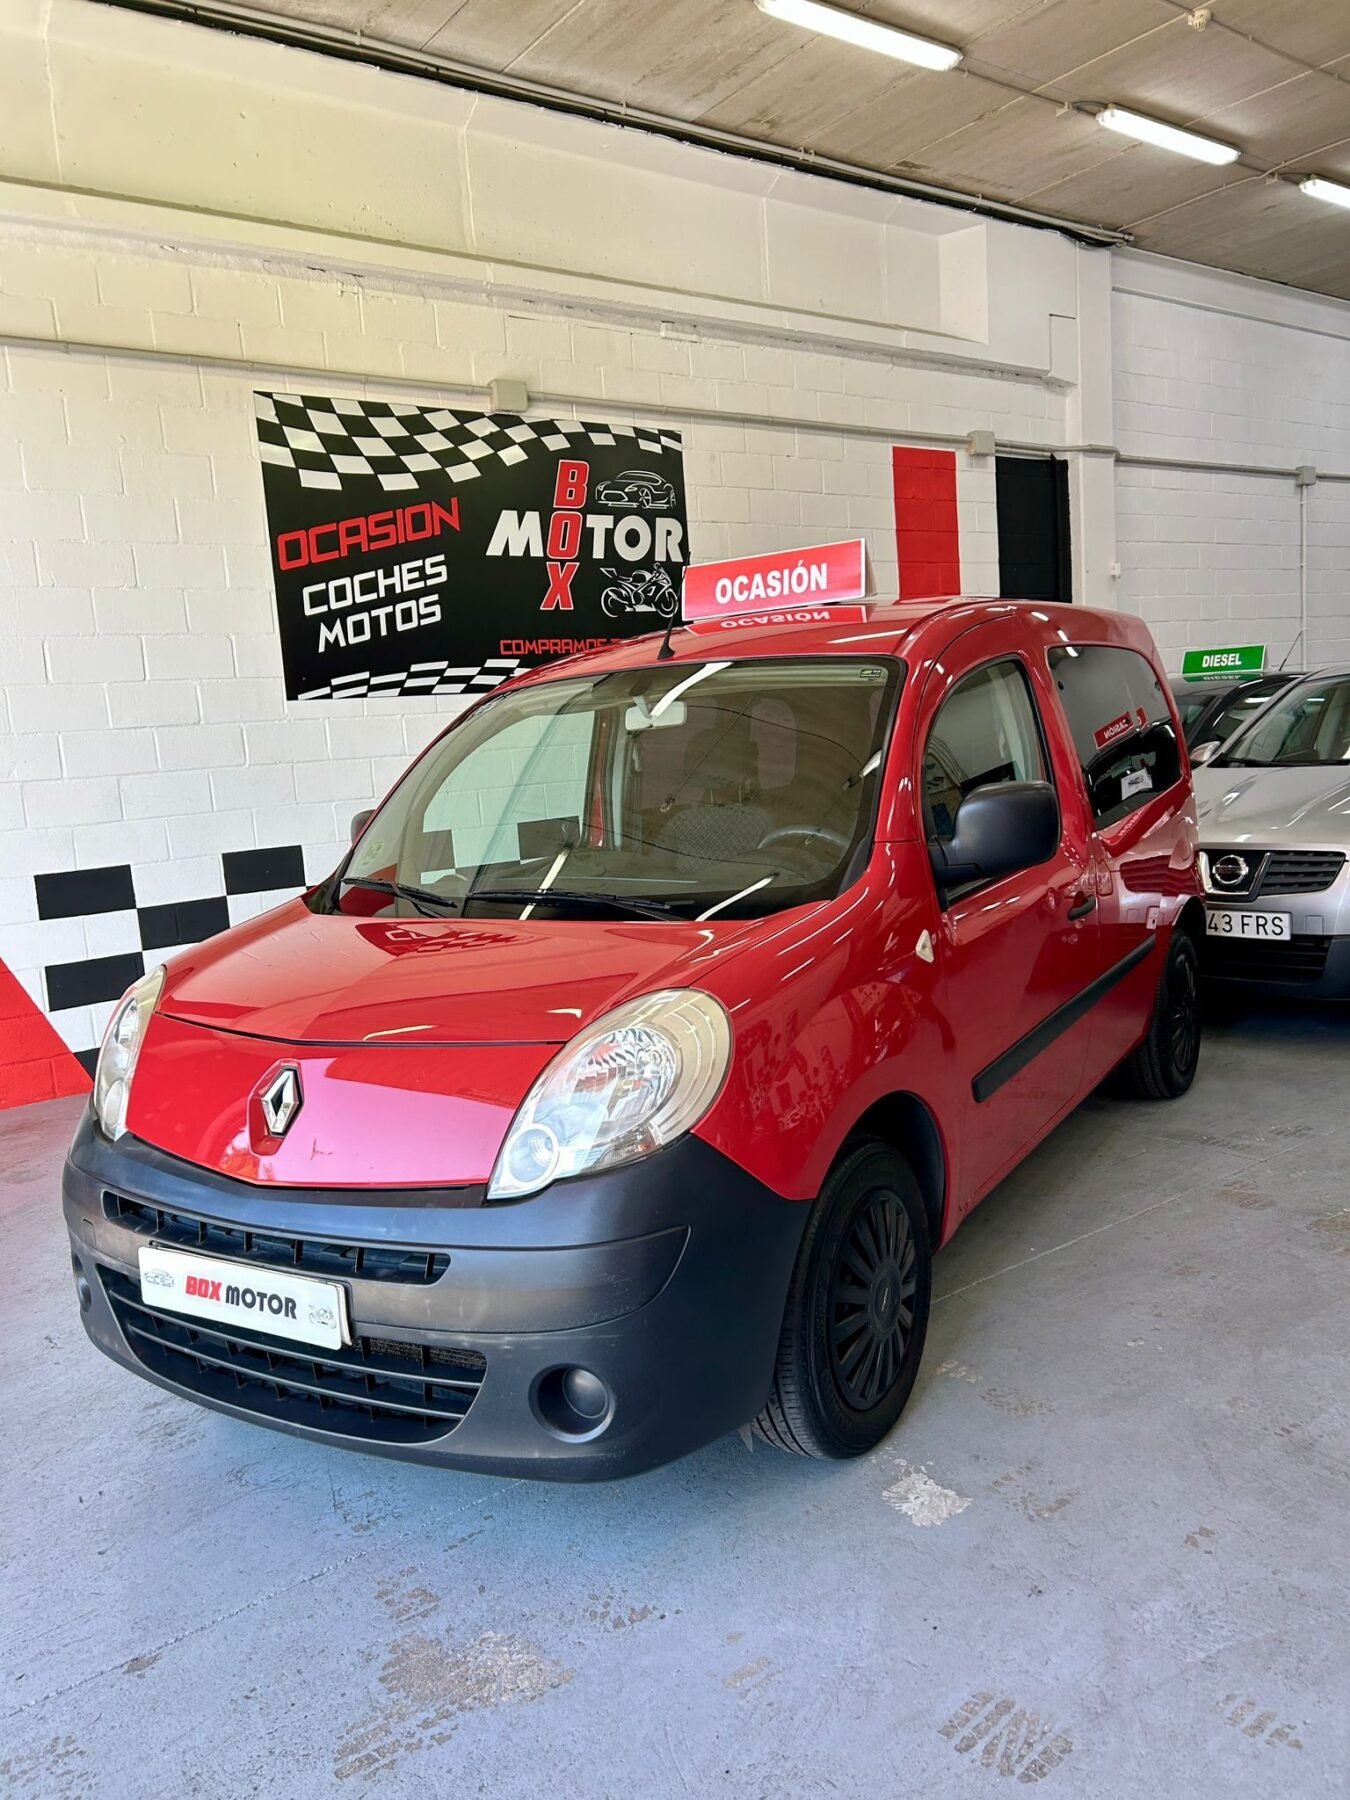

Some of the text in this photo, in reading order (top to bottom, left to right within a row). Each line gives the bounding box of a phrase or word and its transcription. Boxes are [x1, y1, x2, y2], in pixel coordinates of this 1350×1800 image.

[277, 497, 461, 570] OCASION
[485, 510, 684, 562] MOTOR
[540, 459, 589, 610] BOX
[303, 554, 447, 616] COCHES
[715, 559, 828, 604] OCASIÓN
[318, 594, 442, 652] MOTOS
[1202, 653, 1242, 668] DIESEL
[1241, 914, 1284, 936] FRS
[185, 1275, 297, 1320] BOX MOTOR
